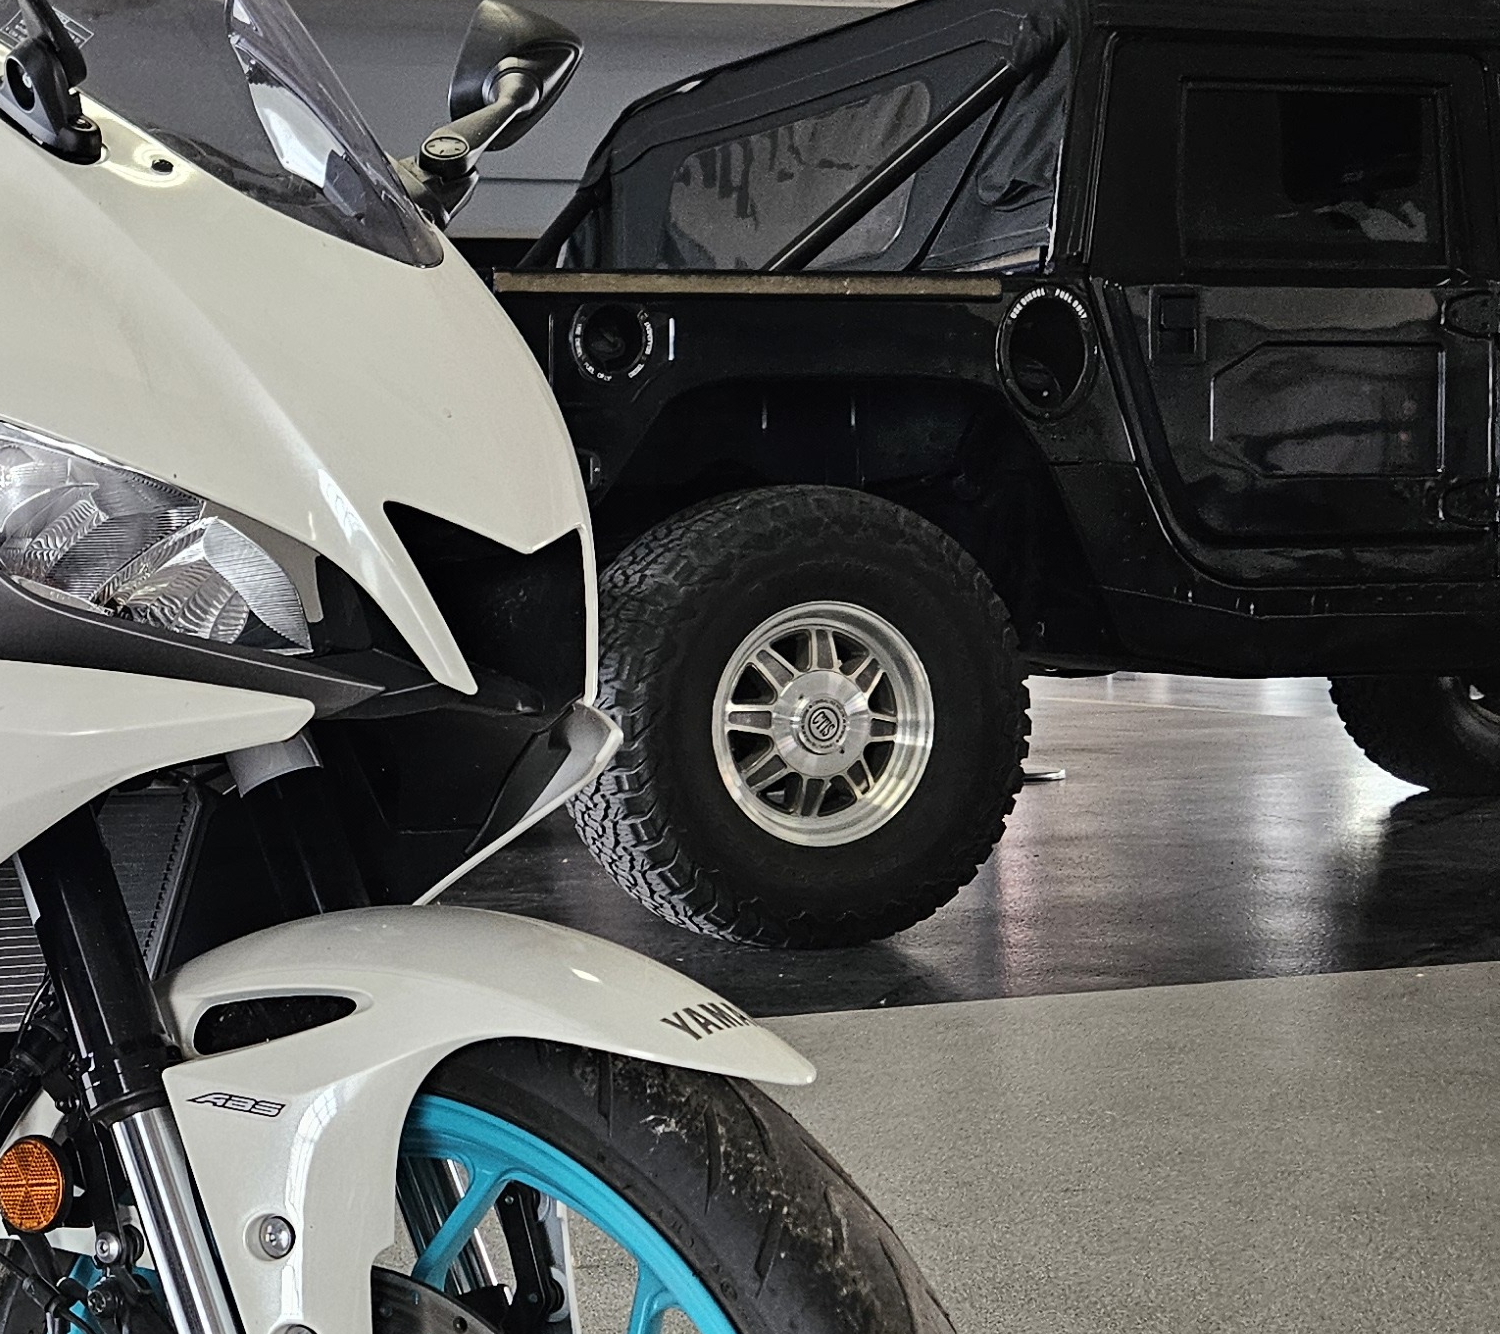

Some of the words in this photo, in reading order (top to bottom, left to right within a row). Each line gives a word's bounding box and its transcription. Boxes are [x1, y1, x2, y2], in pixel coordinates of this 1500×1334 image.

[1054, 288, 1073, 304] FUEL
[1071, 299, 1088, 319] ONLY
[584, 362, 595, 374] FUEL
[812, 710, 836, 737] CTIS
[185, 1092, 286, 1117] ABS
